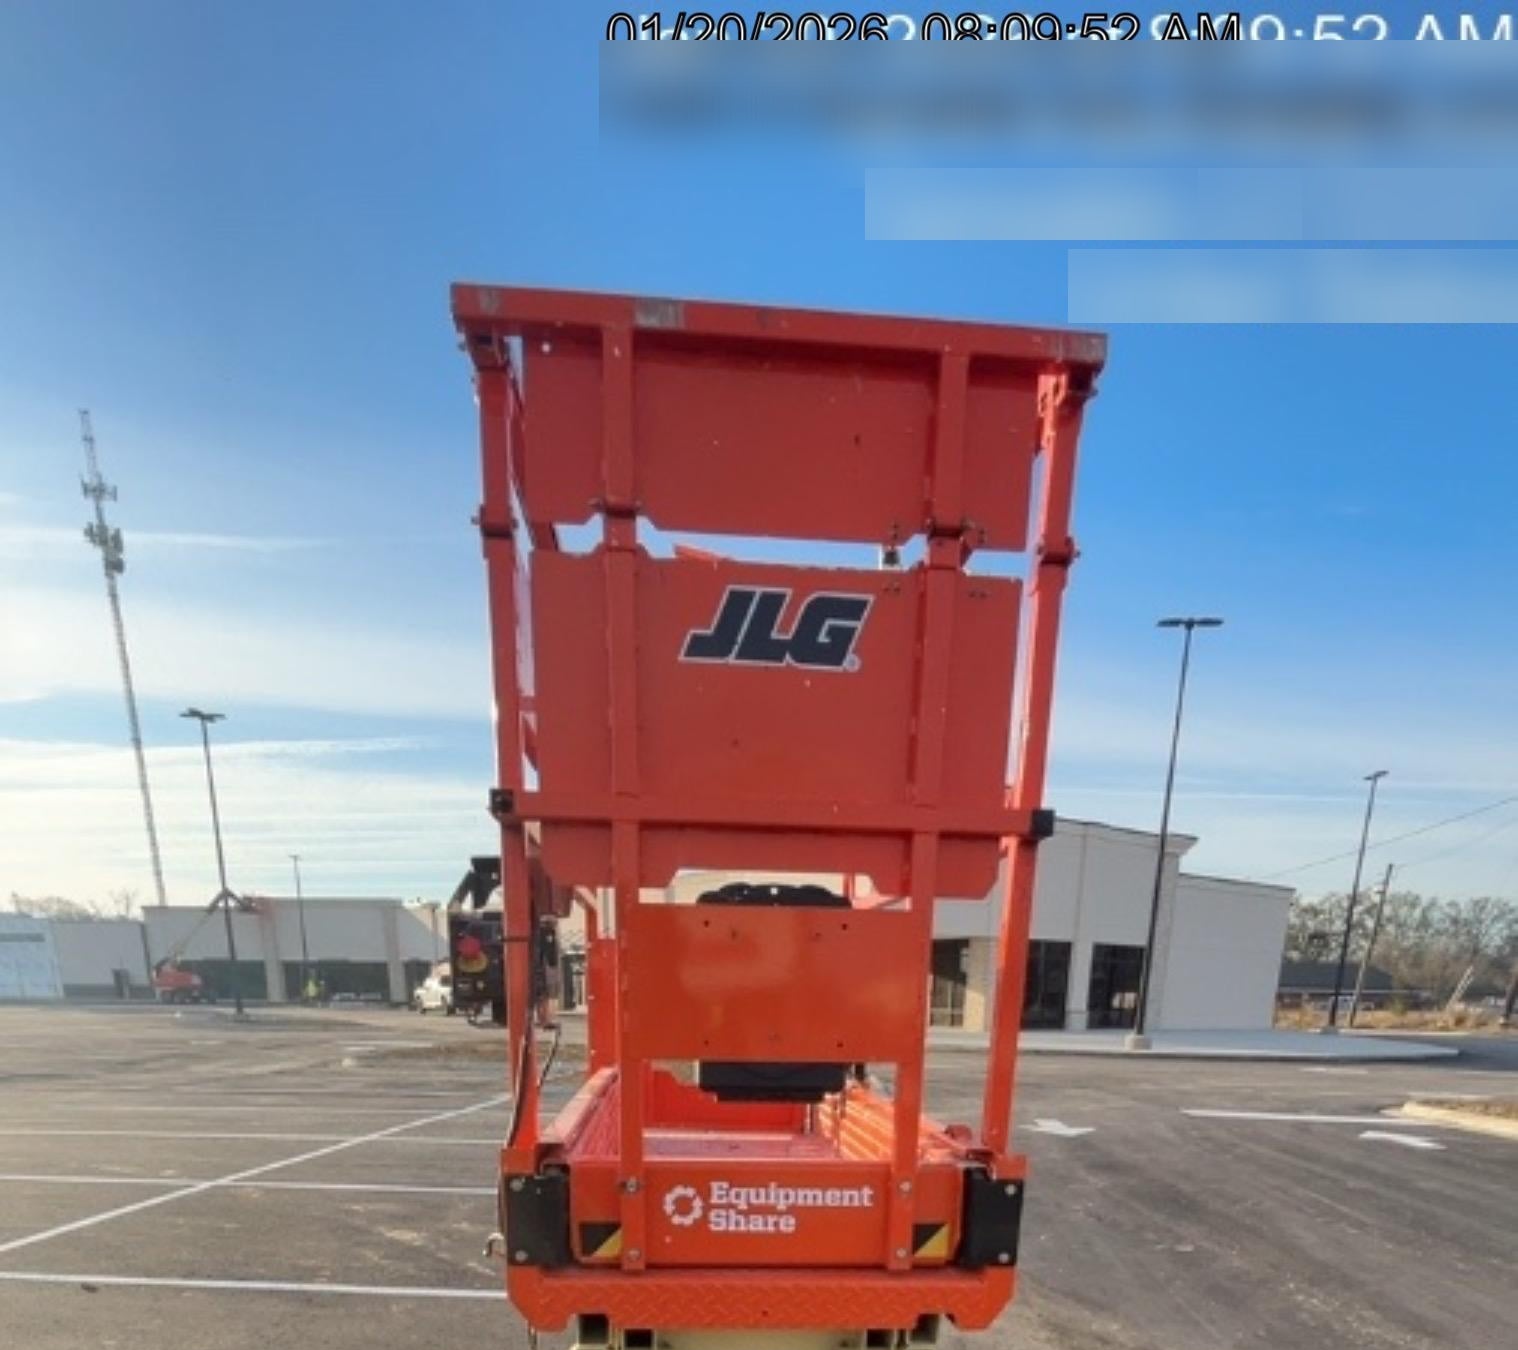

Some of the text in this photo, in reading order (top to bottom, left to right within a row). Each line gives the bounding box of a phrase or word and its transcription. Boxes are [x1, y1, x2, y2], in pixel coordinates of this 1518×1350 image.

[679, 585, 875, 671] JLG
[709, 1181, 874, 1210] Equipment
[708, 1208, 796, 1232] Share
